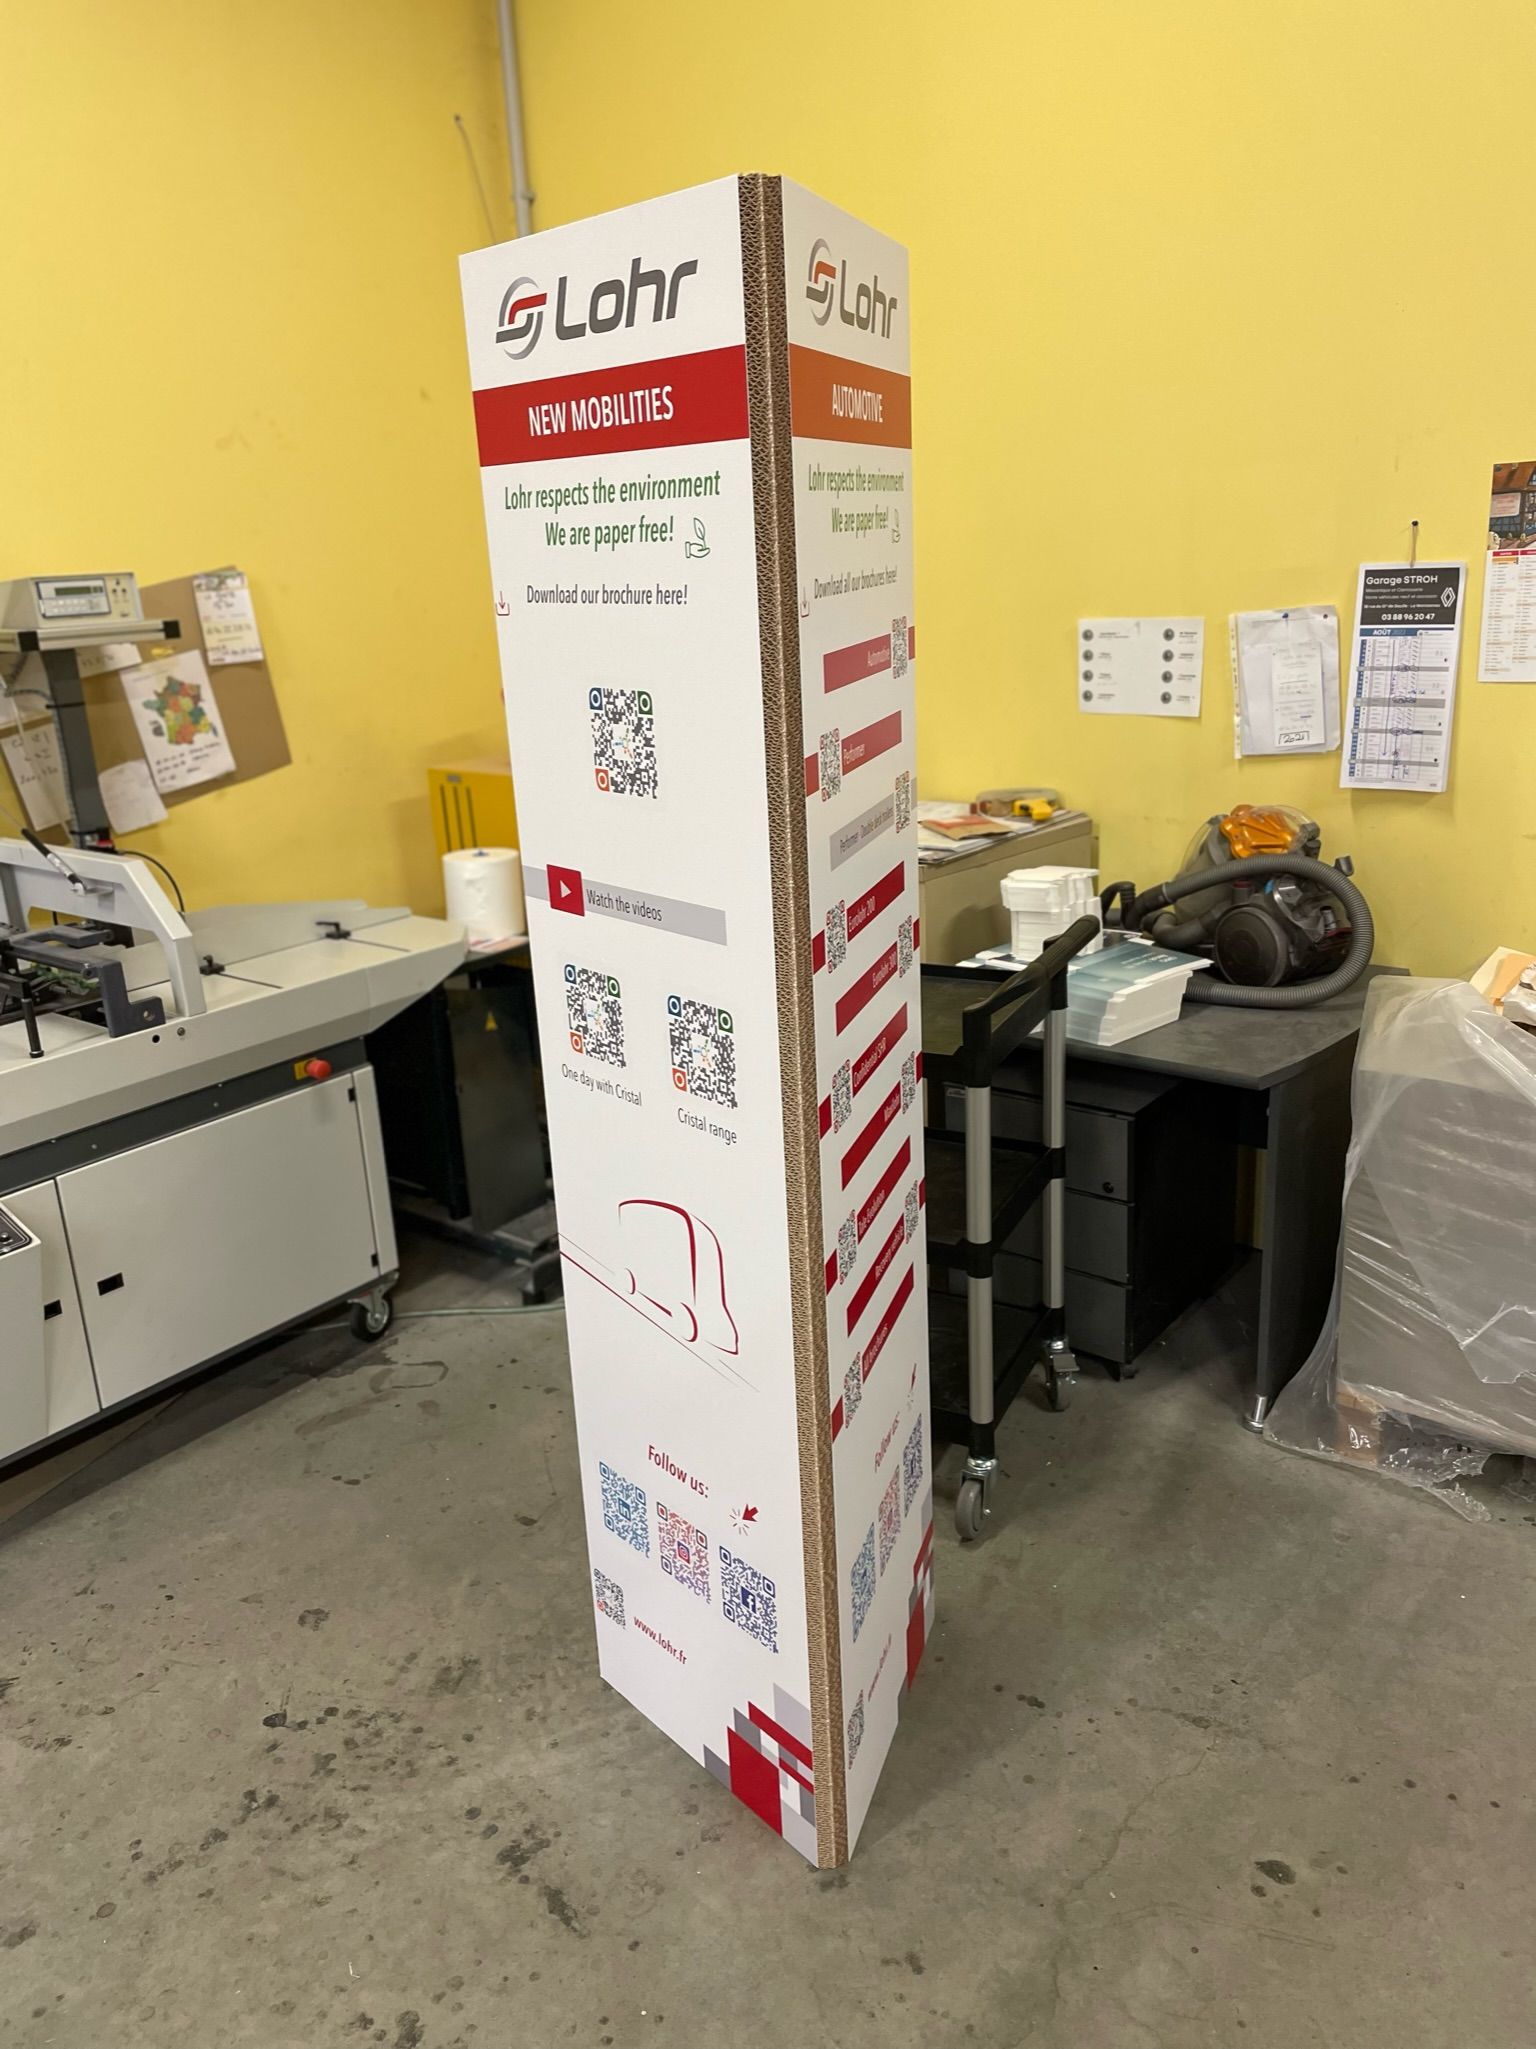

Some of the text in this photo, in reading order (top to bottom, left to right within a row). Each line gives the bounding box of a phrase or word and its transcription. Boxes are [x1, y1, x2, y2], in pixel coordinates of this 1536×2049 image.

[555, 257, 698, 341] Lohr
[840, 259, 897, 339] Lohr
[528, 385, 674, 437] NEW MOBILITIES
[832, 384, 883, 423] AUTOMOTIVE
[505, 470, 721, 514] Lohr respects the environment
[808, 463, 904, 499] Lohr respects the environment
[545, 515, 674, 552] We are paper free!
[832, 507, 843, 533] We
[844, 512, 854, 532] are
[856, 511, 875, 539] paper
[527, 583, 688, 605] Download our brochure here!
[814, 573, 843, 599] Download
[852, 575, 861, 592] our
[1366, 575, 1438, 586] Garage STROH
[586, 888, 662, 922] Watch the videos
[562, 1063, 642, 1106] One day with Cristal
[677, 1107, 737, 1145] Cristal range
[648, 1444, 708, 1498] Follow us:
[633, 1616, 687, 1665] www.lohr.fr
